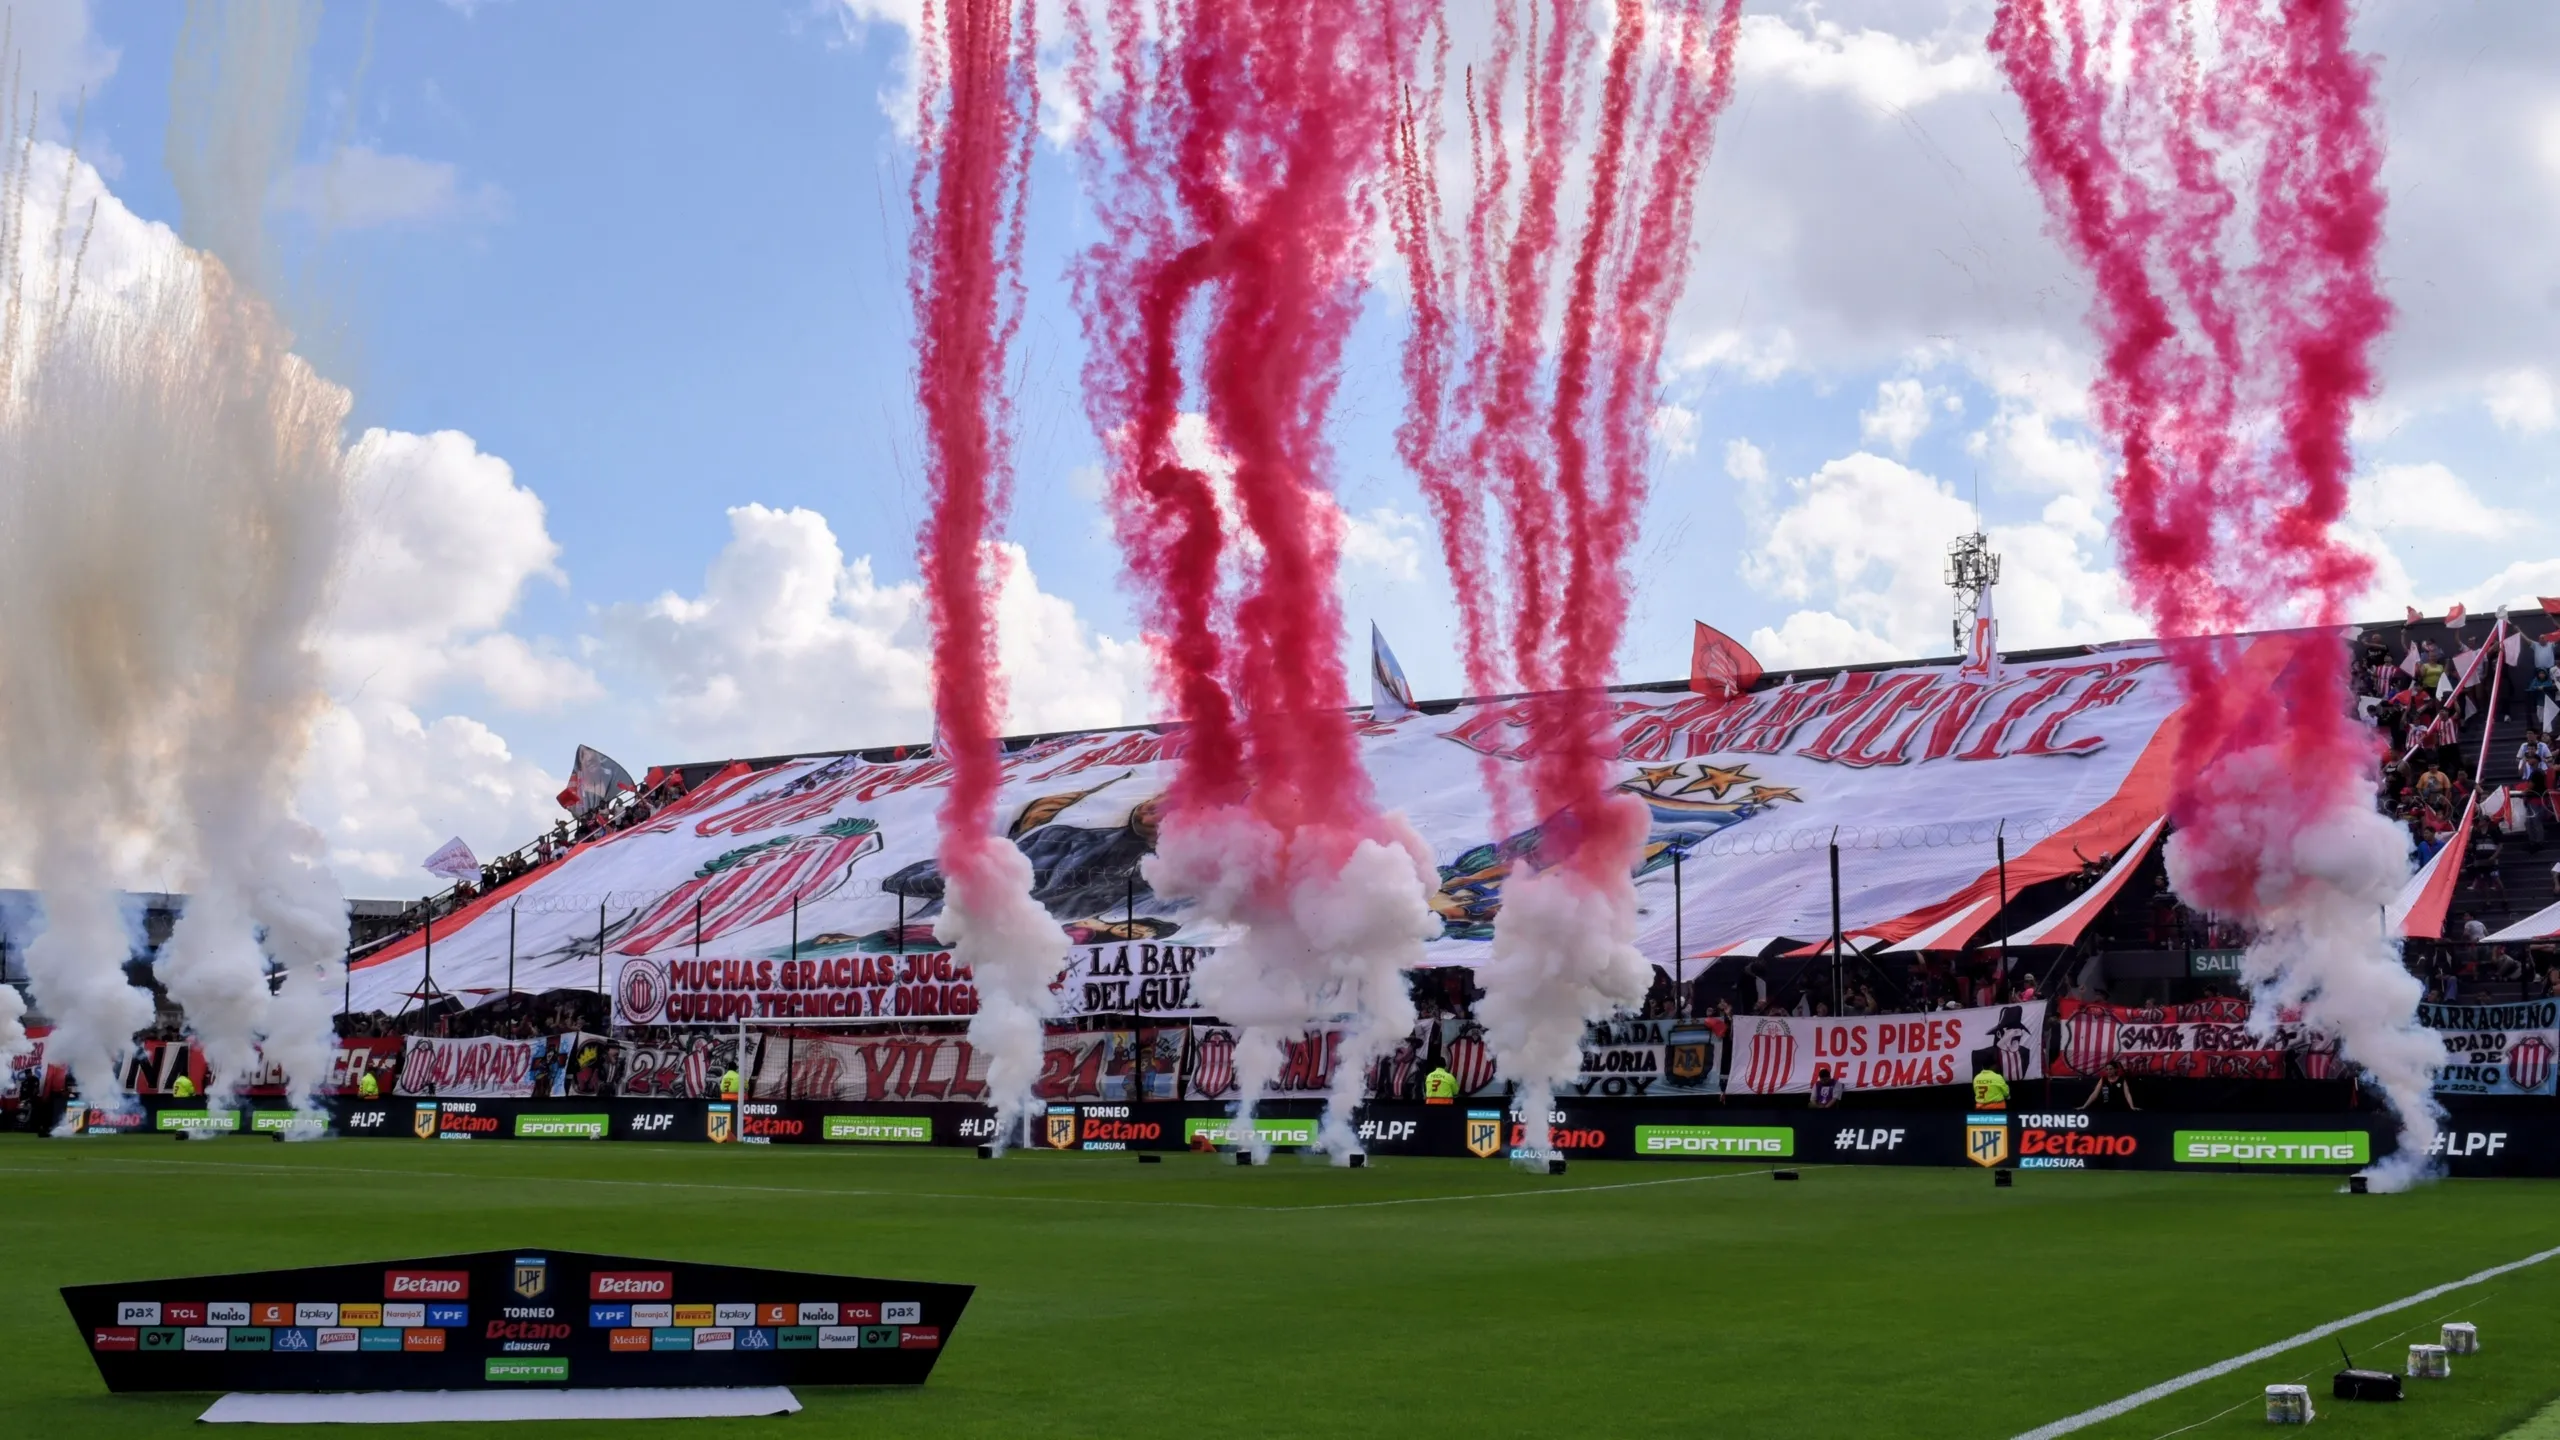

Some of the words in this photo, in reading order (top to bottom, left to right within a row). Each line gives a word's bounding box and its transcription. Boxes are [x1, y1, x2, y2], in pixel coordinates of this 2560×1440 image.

[1087, 946, 1133, 976] LA
[1139, 944, 1215, 976] BAR
[670, 960, 773, 991] MUCHAS
[781, 955, 894, 990] GRACIAS
[1083, 981, 1134, 1012] DEL
[666, 993, 752, 1022] CUERPO
[757, 991, 862, 1018] TECNICO
[866, 988, 887, 1017] Y
[1815, 1027, 1867, 1057] LOS
[1878, 1019, 1962, 1055] PIBES
[2470, 1051, 2502, 1063] DE
[431, 1043, 532, 1090] ALVARADO
[854, 1038, 991, 1100] VILL
[1856, 1054, 1954, 1088] LOMAS
[441, 1103, 476, 1112] TORNEO
[743, 1104, 778, 1115] ORNEO
[1083, 1107, 1130, 1117] TORNEO
[350, 1113, 386, 1128] #LPF
[631, 1114, 674, 1130] #LPF
[1509, 1110, 1566, 1123] TOEO
[2019, 1114, 2089, 1128] TORNEO
[440, 1114, 498, 1132] Betano
[522, 1123, 601, 1133] SPORTING
[831, 1127, 924, 1137] SPORTING
[1082, 1119, 1161, 1140] Betano
[1358, 1121, 1417, 1141] #LPF
[1510, 1124, 1606, 1148] Btano
[1834, 1128, 1905, 1150] #LPF
[1083, 1142, 1126, 1150] CLAUSURA
[1647, 1138, 1782, 1152] SPORTING
[2020, 1130, 2136, 1156] Betano
[2428, 1132, 2507, 1156] #LPF
[2188, 1144, 2354, 1159] SPORTING
[2020, 1157, 2085, 1168] CLAUSURA
[393, 1276, 460, 1292] Betano
[598, 1278, 665, 1293] Betano
[124, 1307, 154, 1320] pax
[171, 1309, 198, 1318] TCL
[211, 1308, 245, 1321] Naldo
[300, 1309, 333, 1320] bplay
[433, 1311, 463, 1320] YPF
[503, 1307, 555, 1318] TORNEO
[595, 1312, 625, 1320] YPF
[719, 1310, 751, 1320] bplay
[802, 1309, 834, 1321] Naldo
[847, 1309, 872, 1318] TCL
[887, 1307, 914, 1319] pax
[288, 1330, 304, 1339] LA
[485, 1320, 571, 1339] Betano
[750, 1330, 763, 1339] LA
[246, 1335, 266, 1343] WIN
[279, 1338, 308, 1350] CAJA
[407, 1336, 442, 1345] Medifé
[613, 1336, 647, 1345] Medifé
[741, 1338, 769, 1350] CAJA
[794, 1334, 812, 1342] WIN
[504, 1341, 551, 1351] clausura
[489, 1366, 564, 1374] SPORTING
